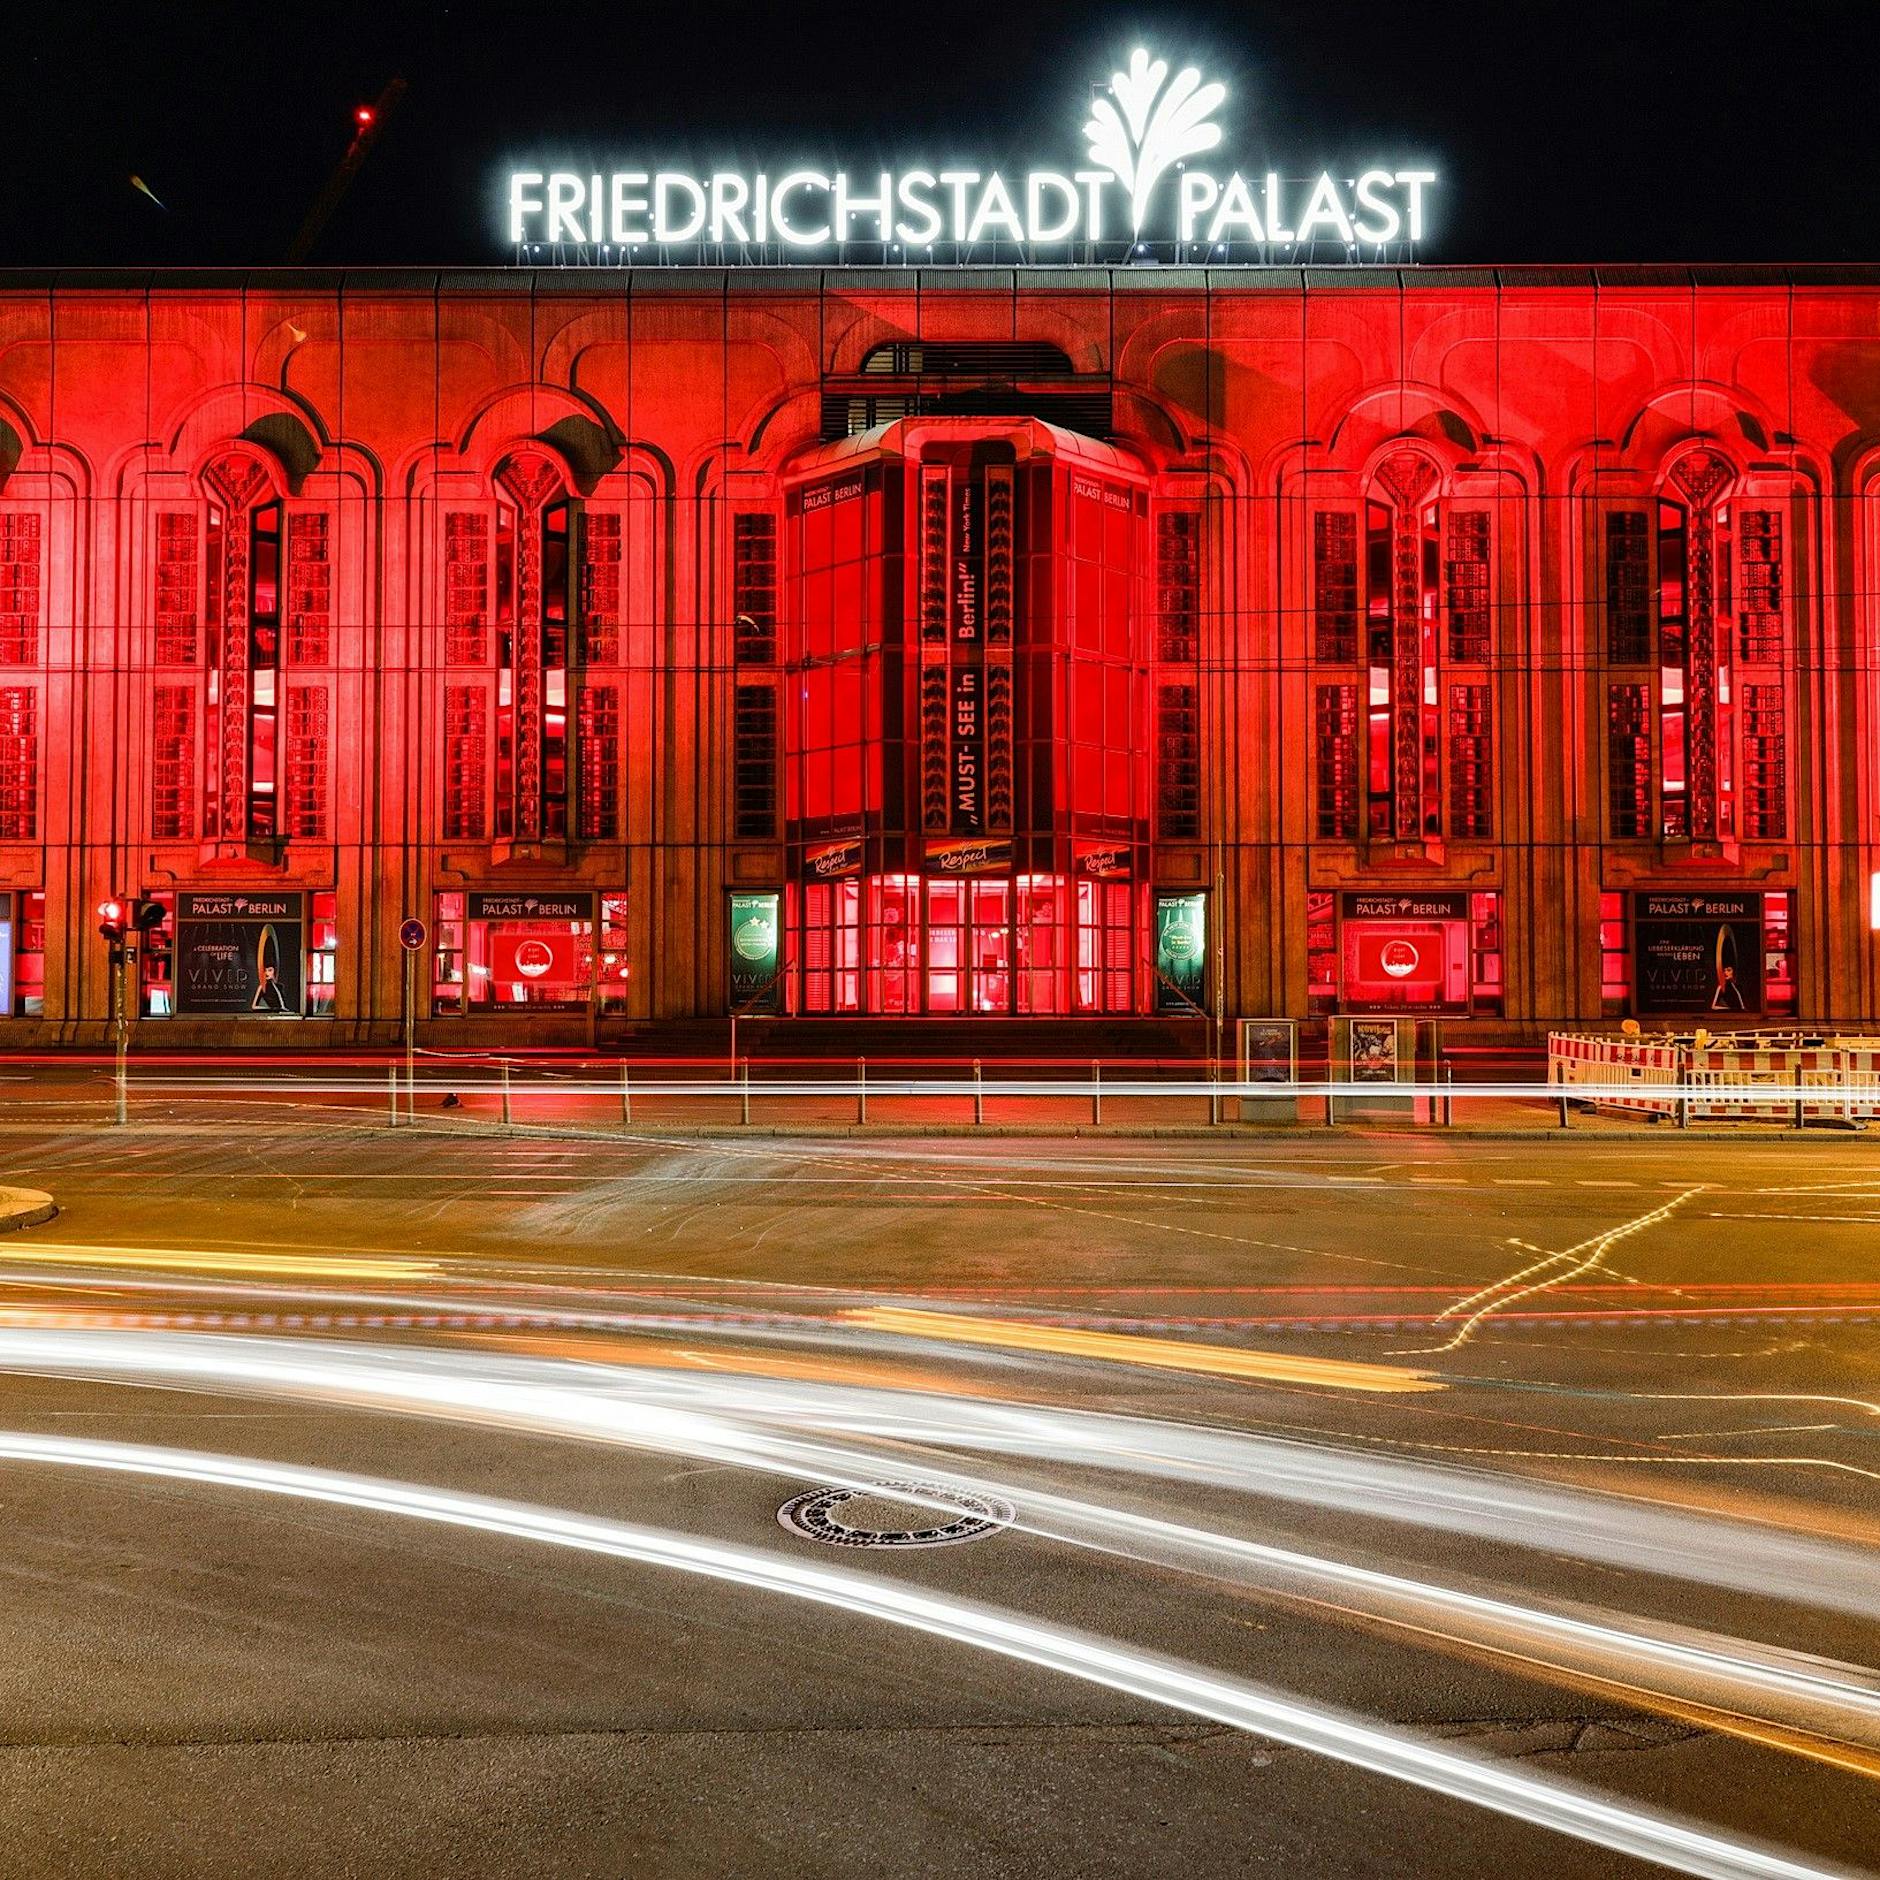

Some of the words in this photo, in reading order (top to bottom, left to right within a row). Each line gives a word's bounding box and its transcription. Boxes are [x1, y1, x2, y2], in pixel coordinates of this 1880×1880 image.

[509, 171, 1115, 244] FRIEDRICHSTADT
[1181, 171, 1435, 244] PALAST
[803, 491, 831, 510] PALAST
[835, 482, 862, 501] BERLIN
[962, 487, 972, 511] Times
[1073, 481, 1101, 501] PALAST
[1104, 491, 1130, 509] BERLIN
[962, 513, 972, 532] York
[962, 536, 972, 553] New
[956, 673, 976, 693] in
[957, 700, 976, 736] SEE
[814, 848, 848, 874] Respect
[939, 847, 989, 870] Respect
[1084, 850, 1117, 873] Respect
[192, 903, 233, 914] PALAST
[248, 903, 287, 914] BERLIN
[482, 904, 523, 915] PALAST
[538, 904, 577, 915] BERLIN
[1356, 903, 1397, 915] PALAST
[1412, 903, 1451, 915] BERLIN
[1648, 903, 1690, 914] PALAST
[1705, 903, 1744, 914] BERLIN
[197, 944, 239, 952] CELEBRATION
[216, 951, 234, 961] LIFE
[1673, 952, 1701, 961] LEBEN
[188, 968, 249, 983] VIVID
